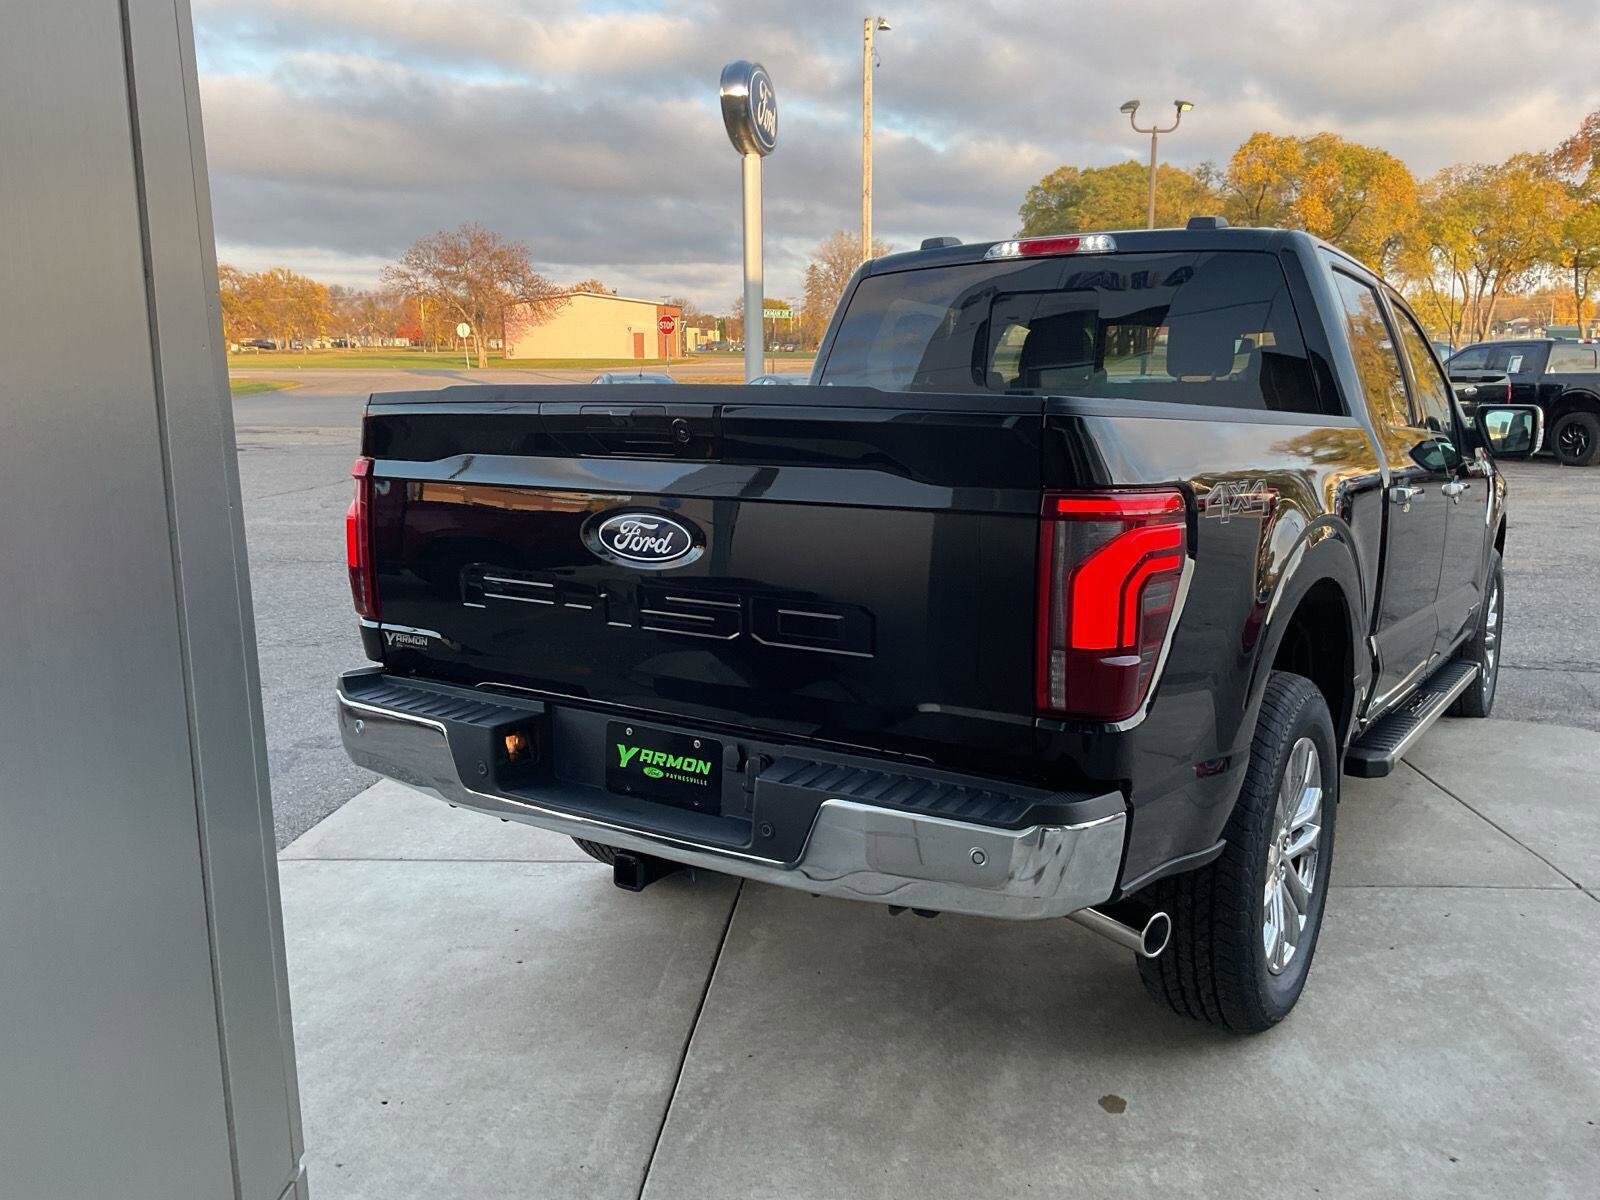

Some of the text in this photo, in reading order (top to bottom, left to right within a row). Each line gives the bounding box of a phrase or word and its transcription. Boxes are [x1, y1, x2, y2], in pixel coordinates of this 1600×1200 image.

[758, 80, 777, 138] Ford
[659, 321, 675, 331] STOP
[613, 520, 674, 555] Ford
[384, 631, 428, 646] YARMON
[616, 743, 712, 775] YARMON
[665, 772, 708, 786] PAYNESVILLE
